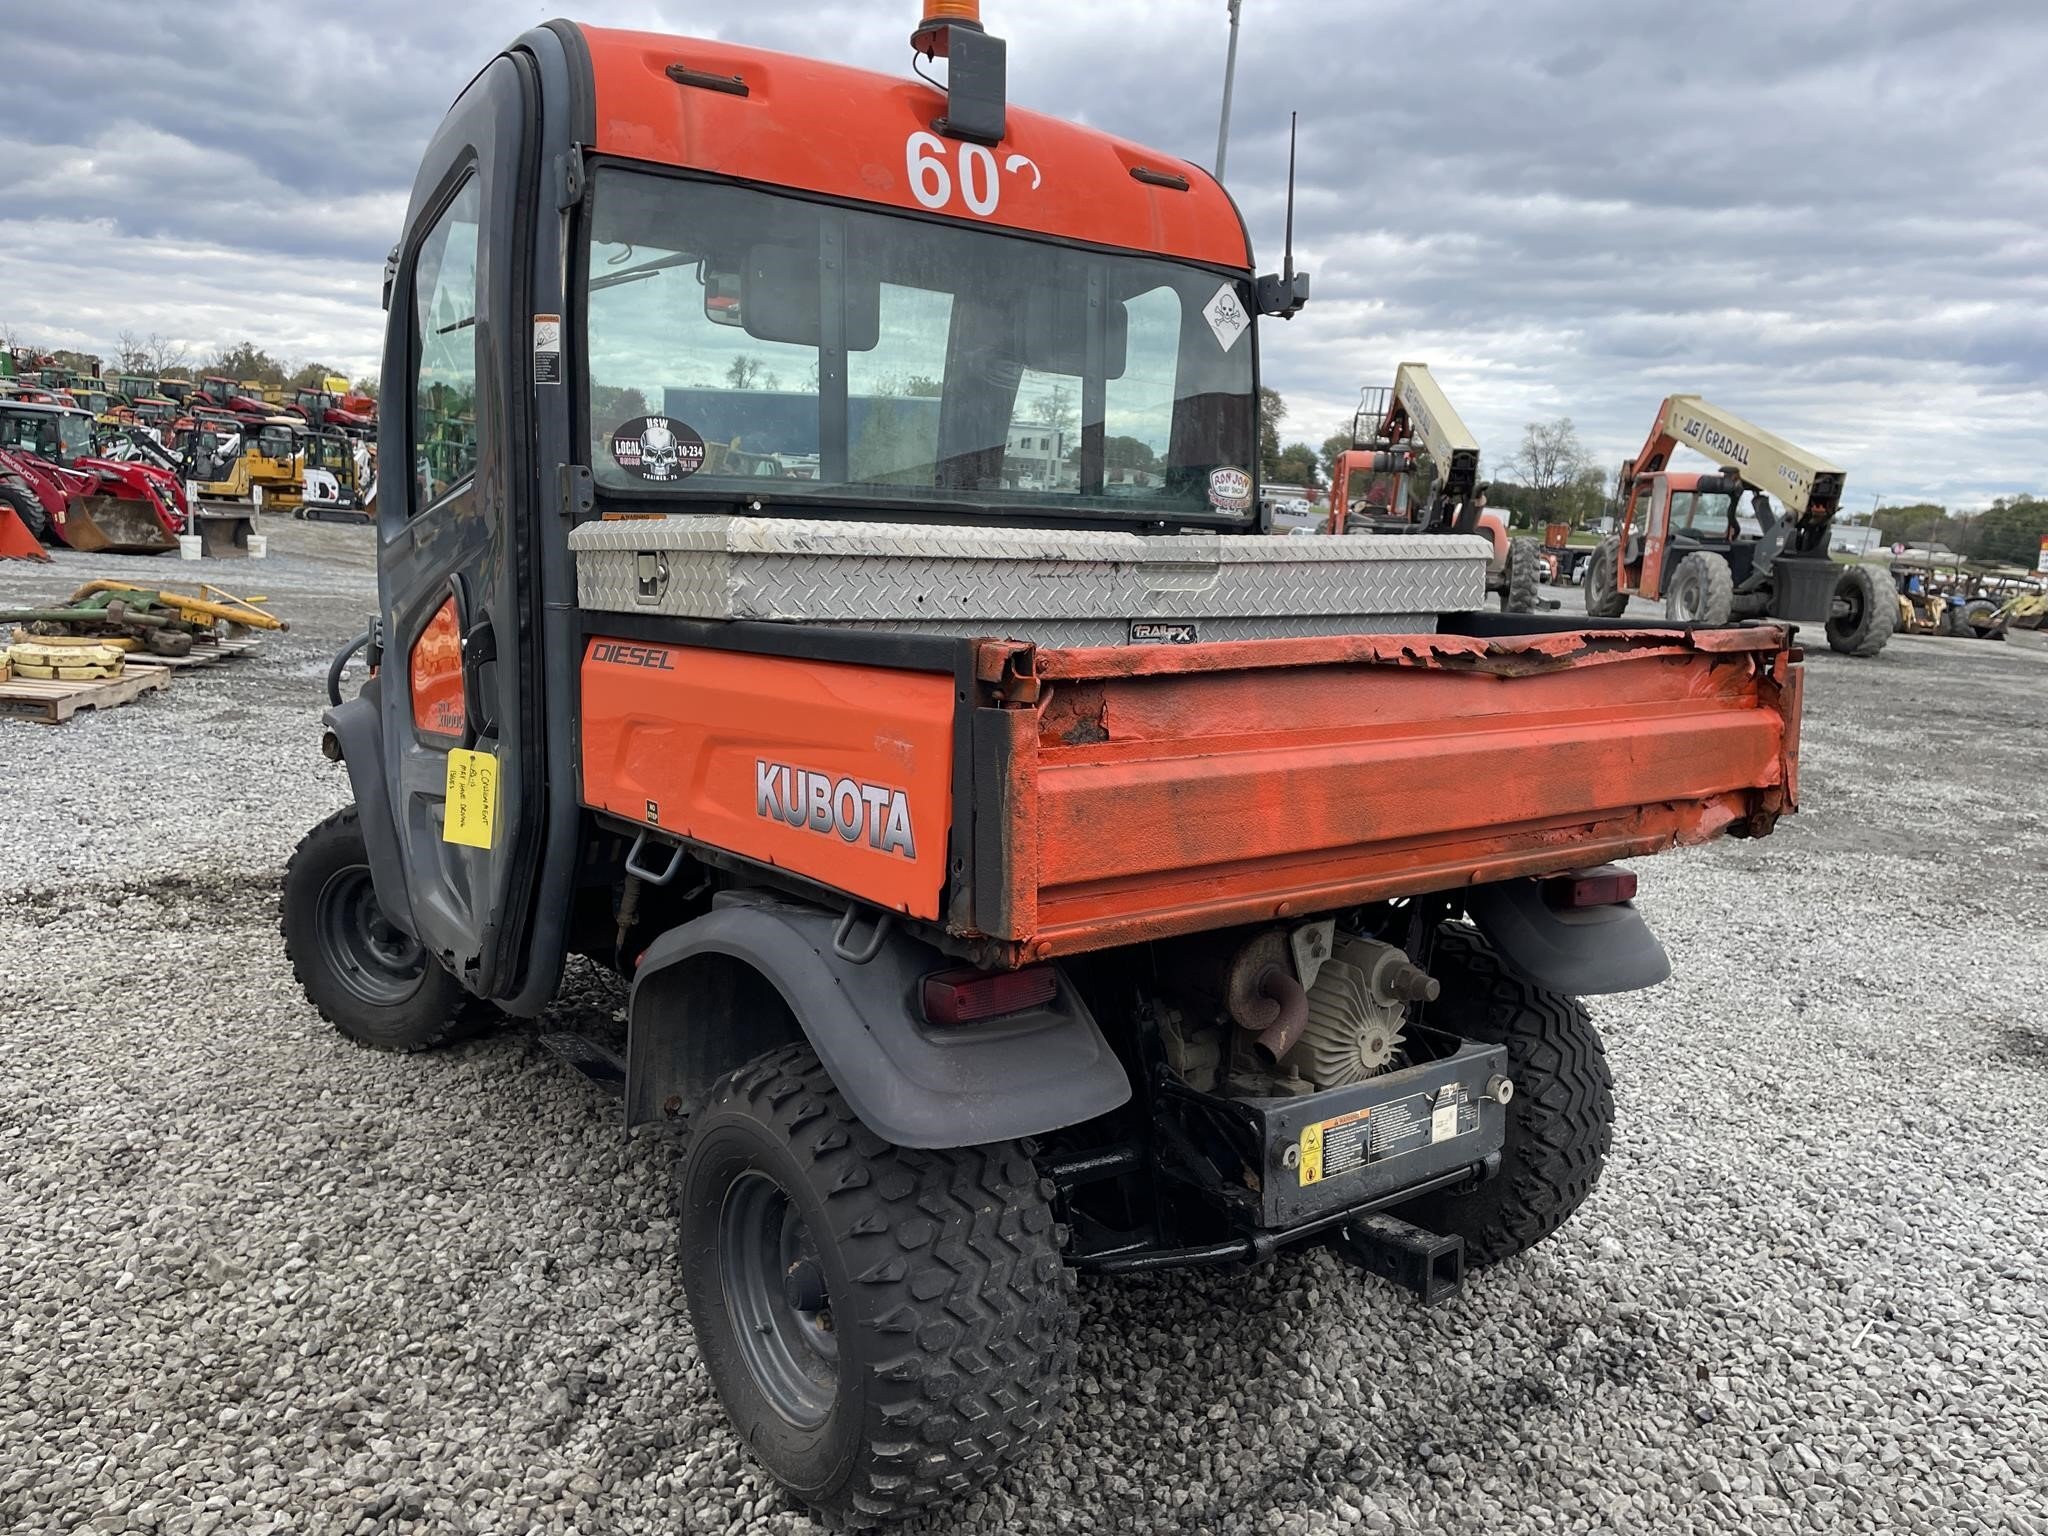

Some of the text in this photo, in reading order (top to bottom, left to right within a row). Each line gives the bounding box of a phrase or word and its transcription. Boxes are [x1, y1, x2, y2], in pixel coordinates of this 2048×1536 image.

[615, 440, 703, 457] LOCAL 10-234
[1705, 428, 1749, 466] GRADALL
[1215, 472, 1249, 488] RON JON
[592, 643, 675, 671] DIESEL
[756, 759, 917, 860] KUBOTA
